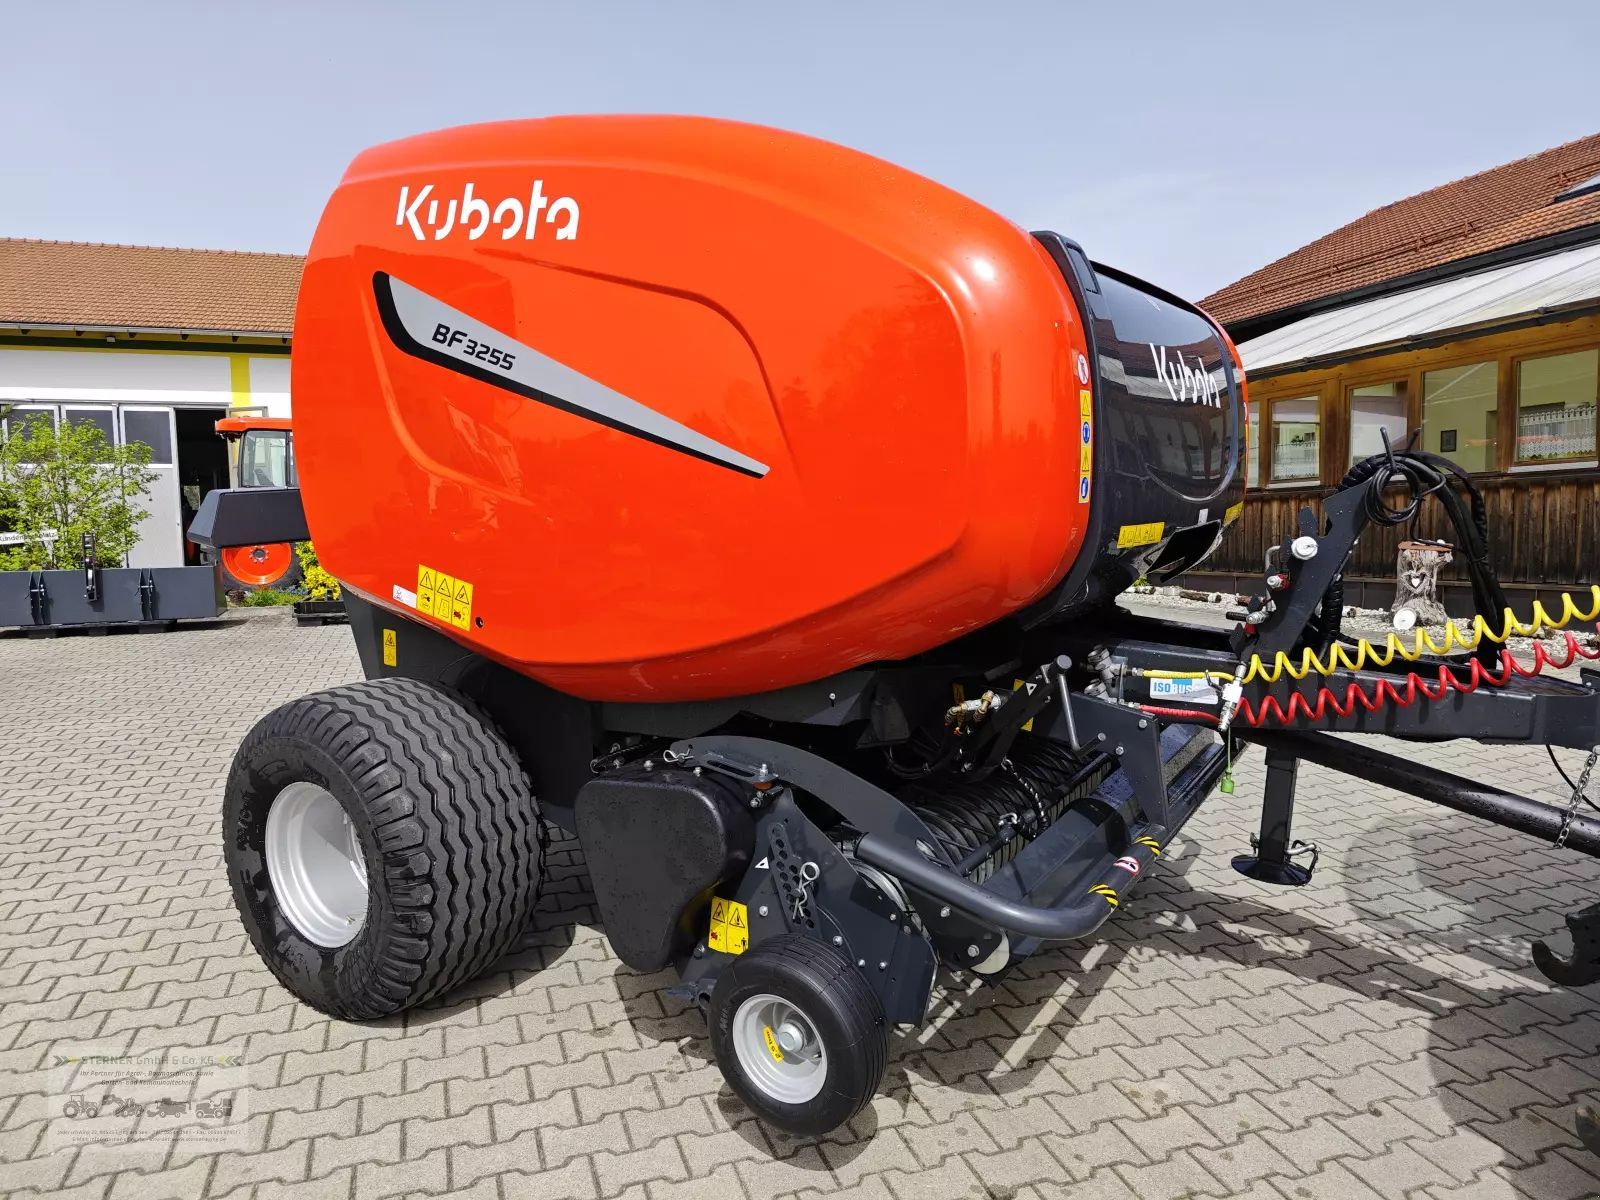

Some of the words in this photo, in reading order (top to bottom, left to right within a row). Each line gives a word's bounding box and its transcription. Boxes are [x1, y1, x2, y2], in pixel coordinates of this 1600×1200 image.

[395, 179, 580, 241] Kubota
[431, 322, 517, 371] BF3255
[1149, 342, 1221, 409] Kubota
